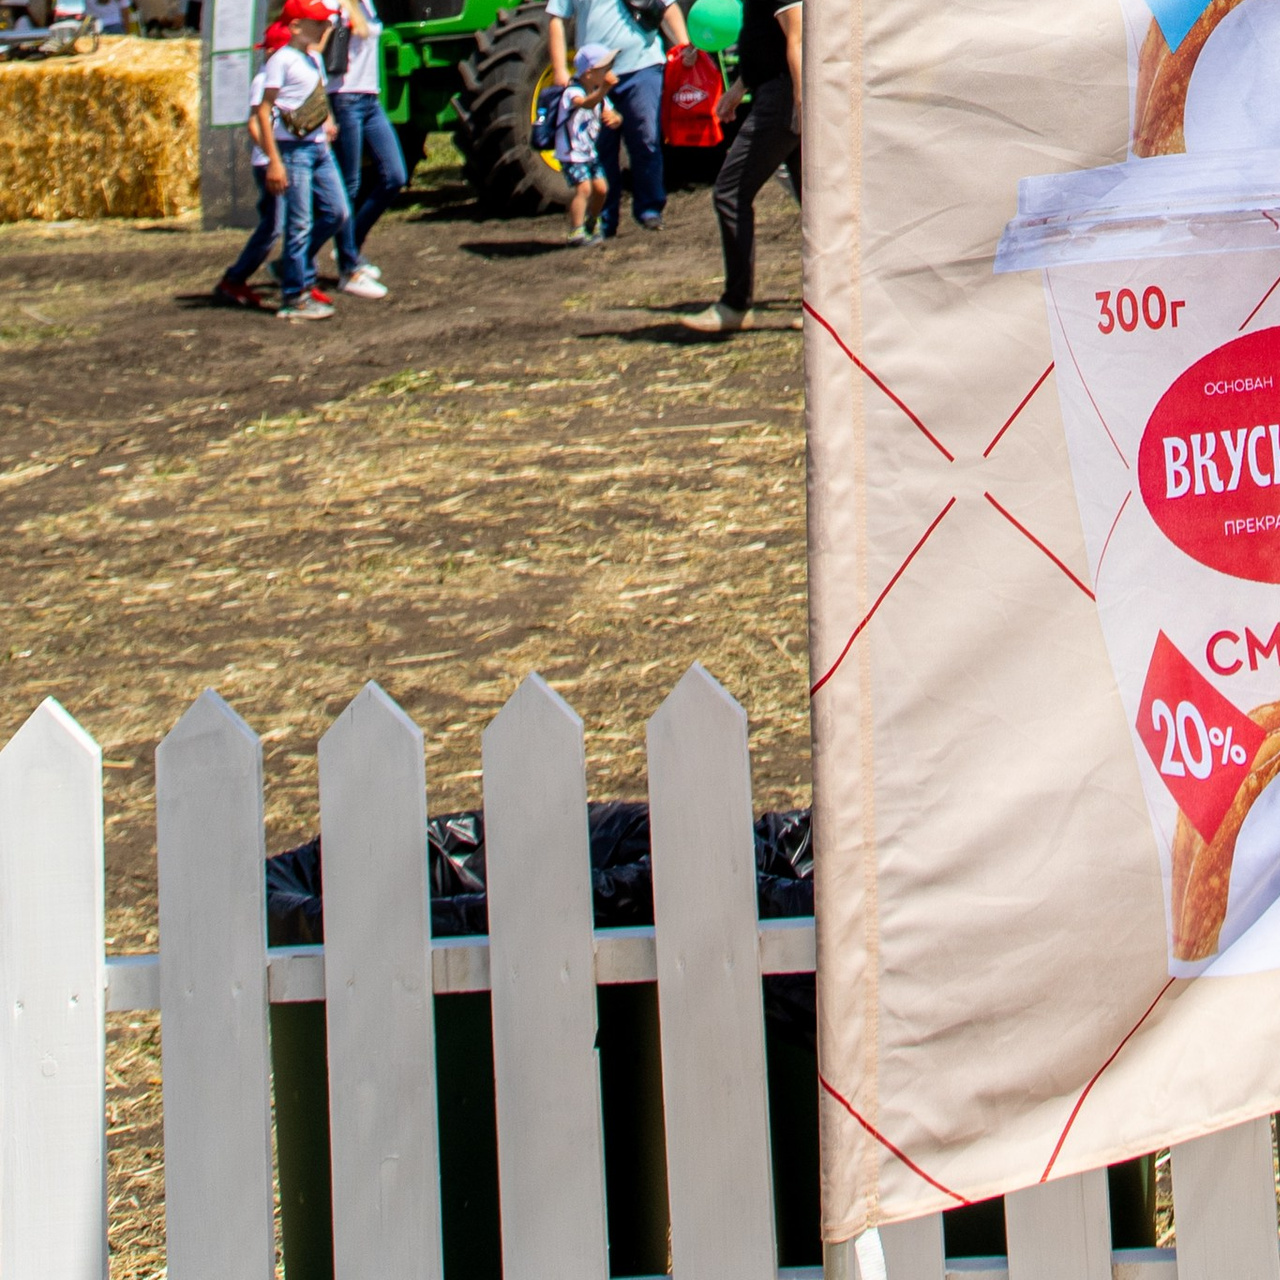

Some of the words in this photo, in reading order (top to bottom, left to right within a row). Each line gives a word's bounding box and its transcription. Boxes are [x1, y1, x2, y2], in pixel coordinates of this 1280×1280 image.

[1095, 285, 1187, 335] 300г
[1204, 376, 1274, 396] ОСНОВАН
[1151, 698, 1248, 781] 20%
